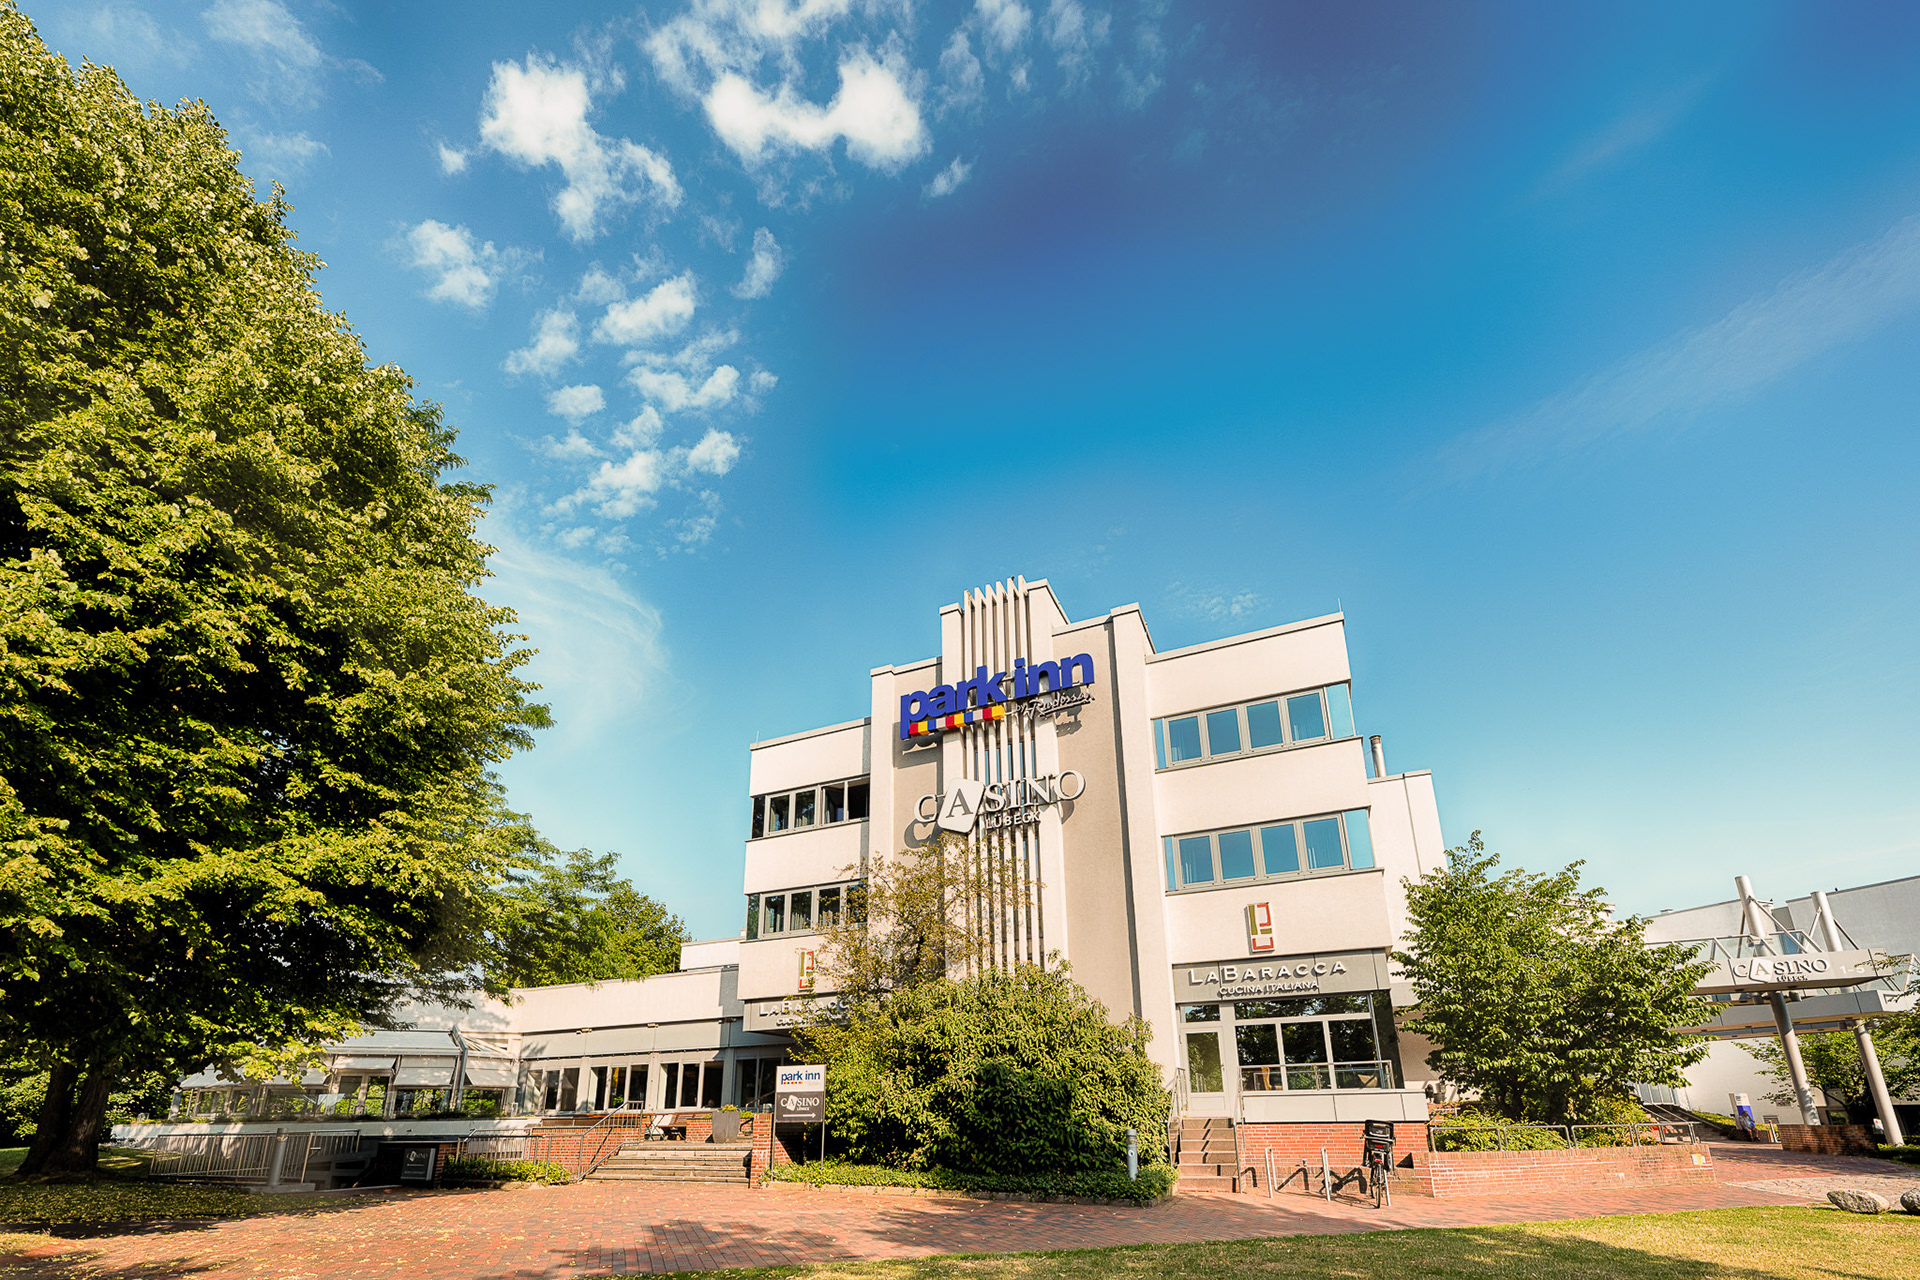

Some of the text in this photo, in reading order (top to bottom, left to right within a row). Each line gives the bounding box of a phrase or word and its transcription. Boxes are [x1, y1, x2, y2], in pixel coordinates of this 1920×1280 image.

[900, 652, 1095, 740] park inn
[913, 769, 1086, 826] CASINO
[985, 811, 1041, 829] LÜBECK
[1733, 958, 1830, 979] CASINO
[1219, 980, 1320, 996] CUCINA ITALIANA
[780, 1070, 821, 1085] park inn
[780, 1095, 820, 1109] CASINO
